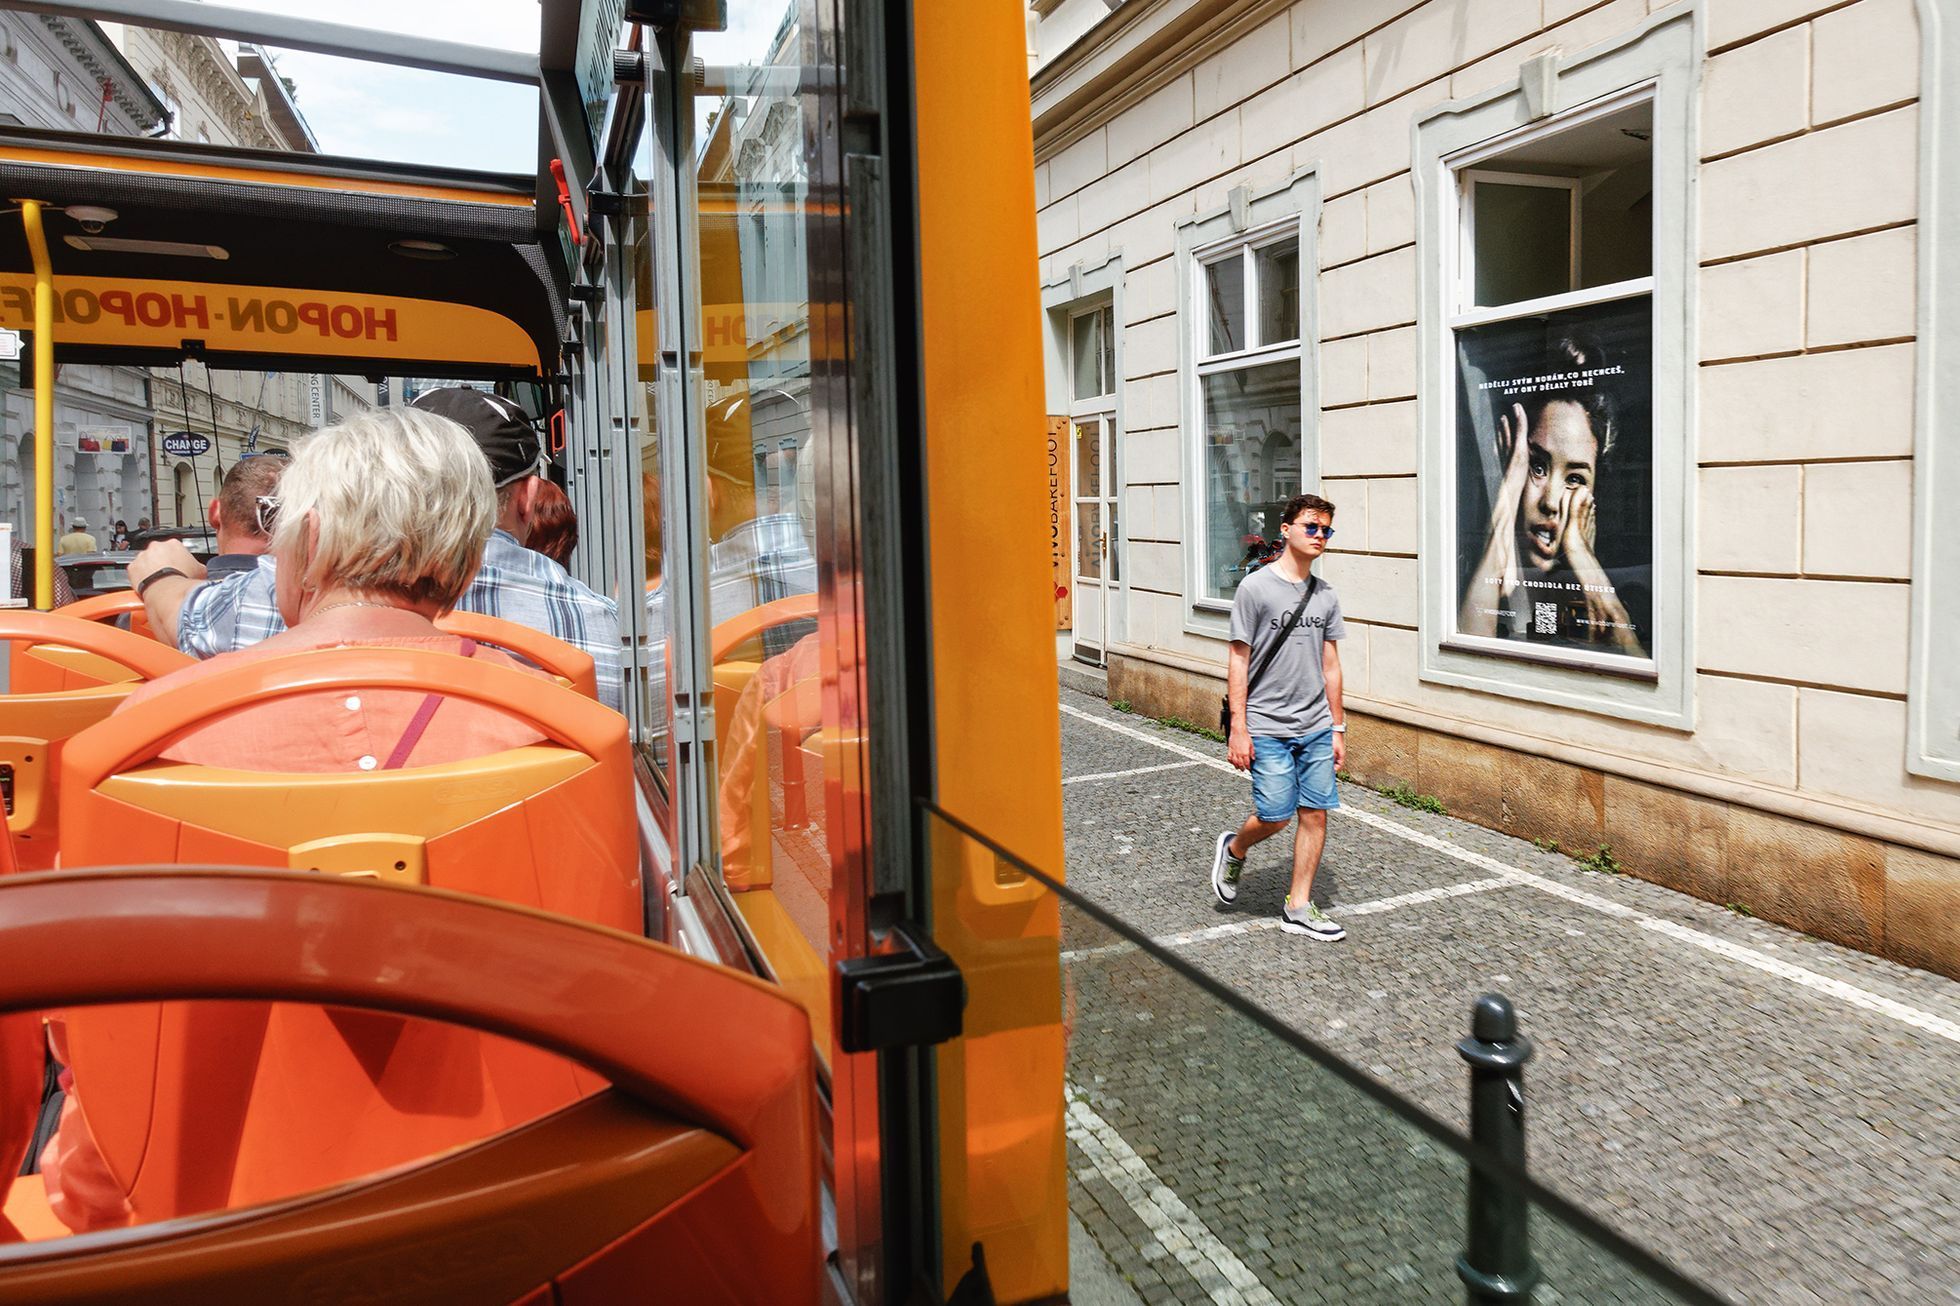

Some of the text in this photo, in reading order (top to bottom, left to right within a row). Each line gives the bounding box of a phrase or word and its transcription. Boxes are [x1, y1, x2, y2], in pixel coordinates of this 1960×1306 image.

[310, 386, 321, 419] CENTER
[165, 439, 208, 450] CHANGE
[1522, 580, 1563, 590] CHODIDLA
[1565, 582, 1582, 591] BEZ
